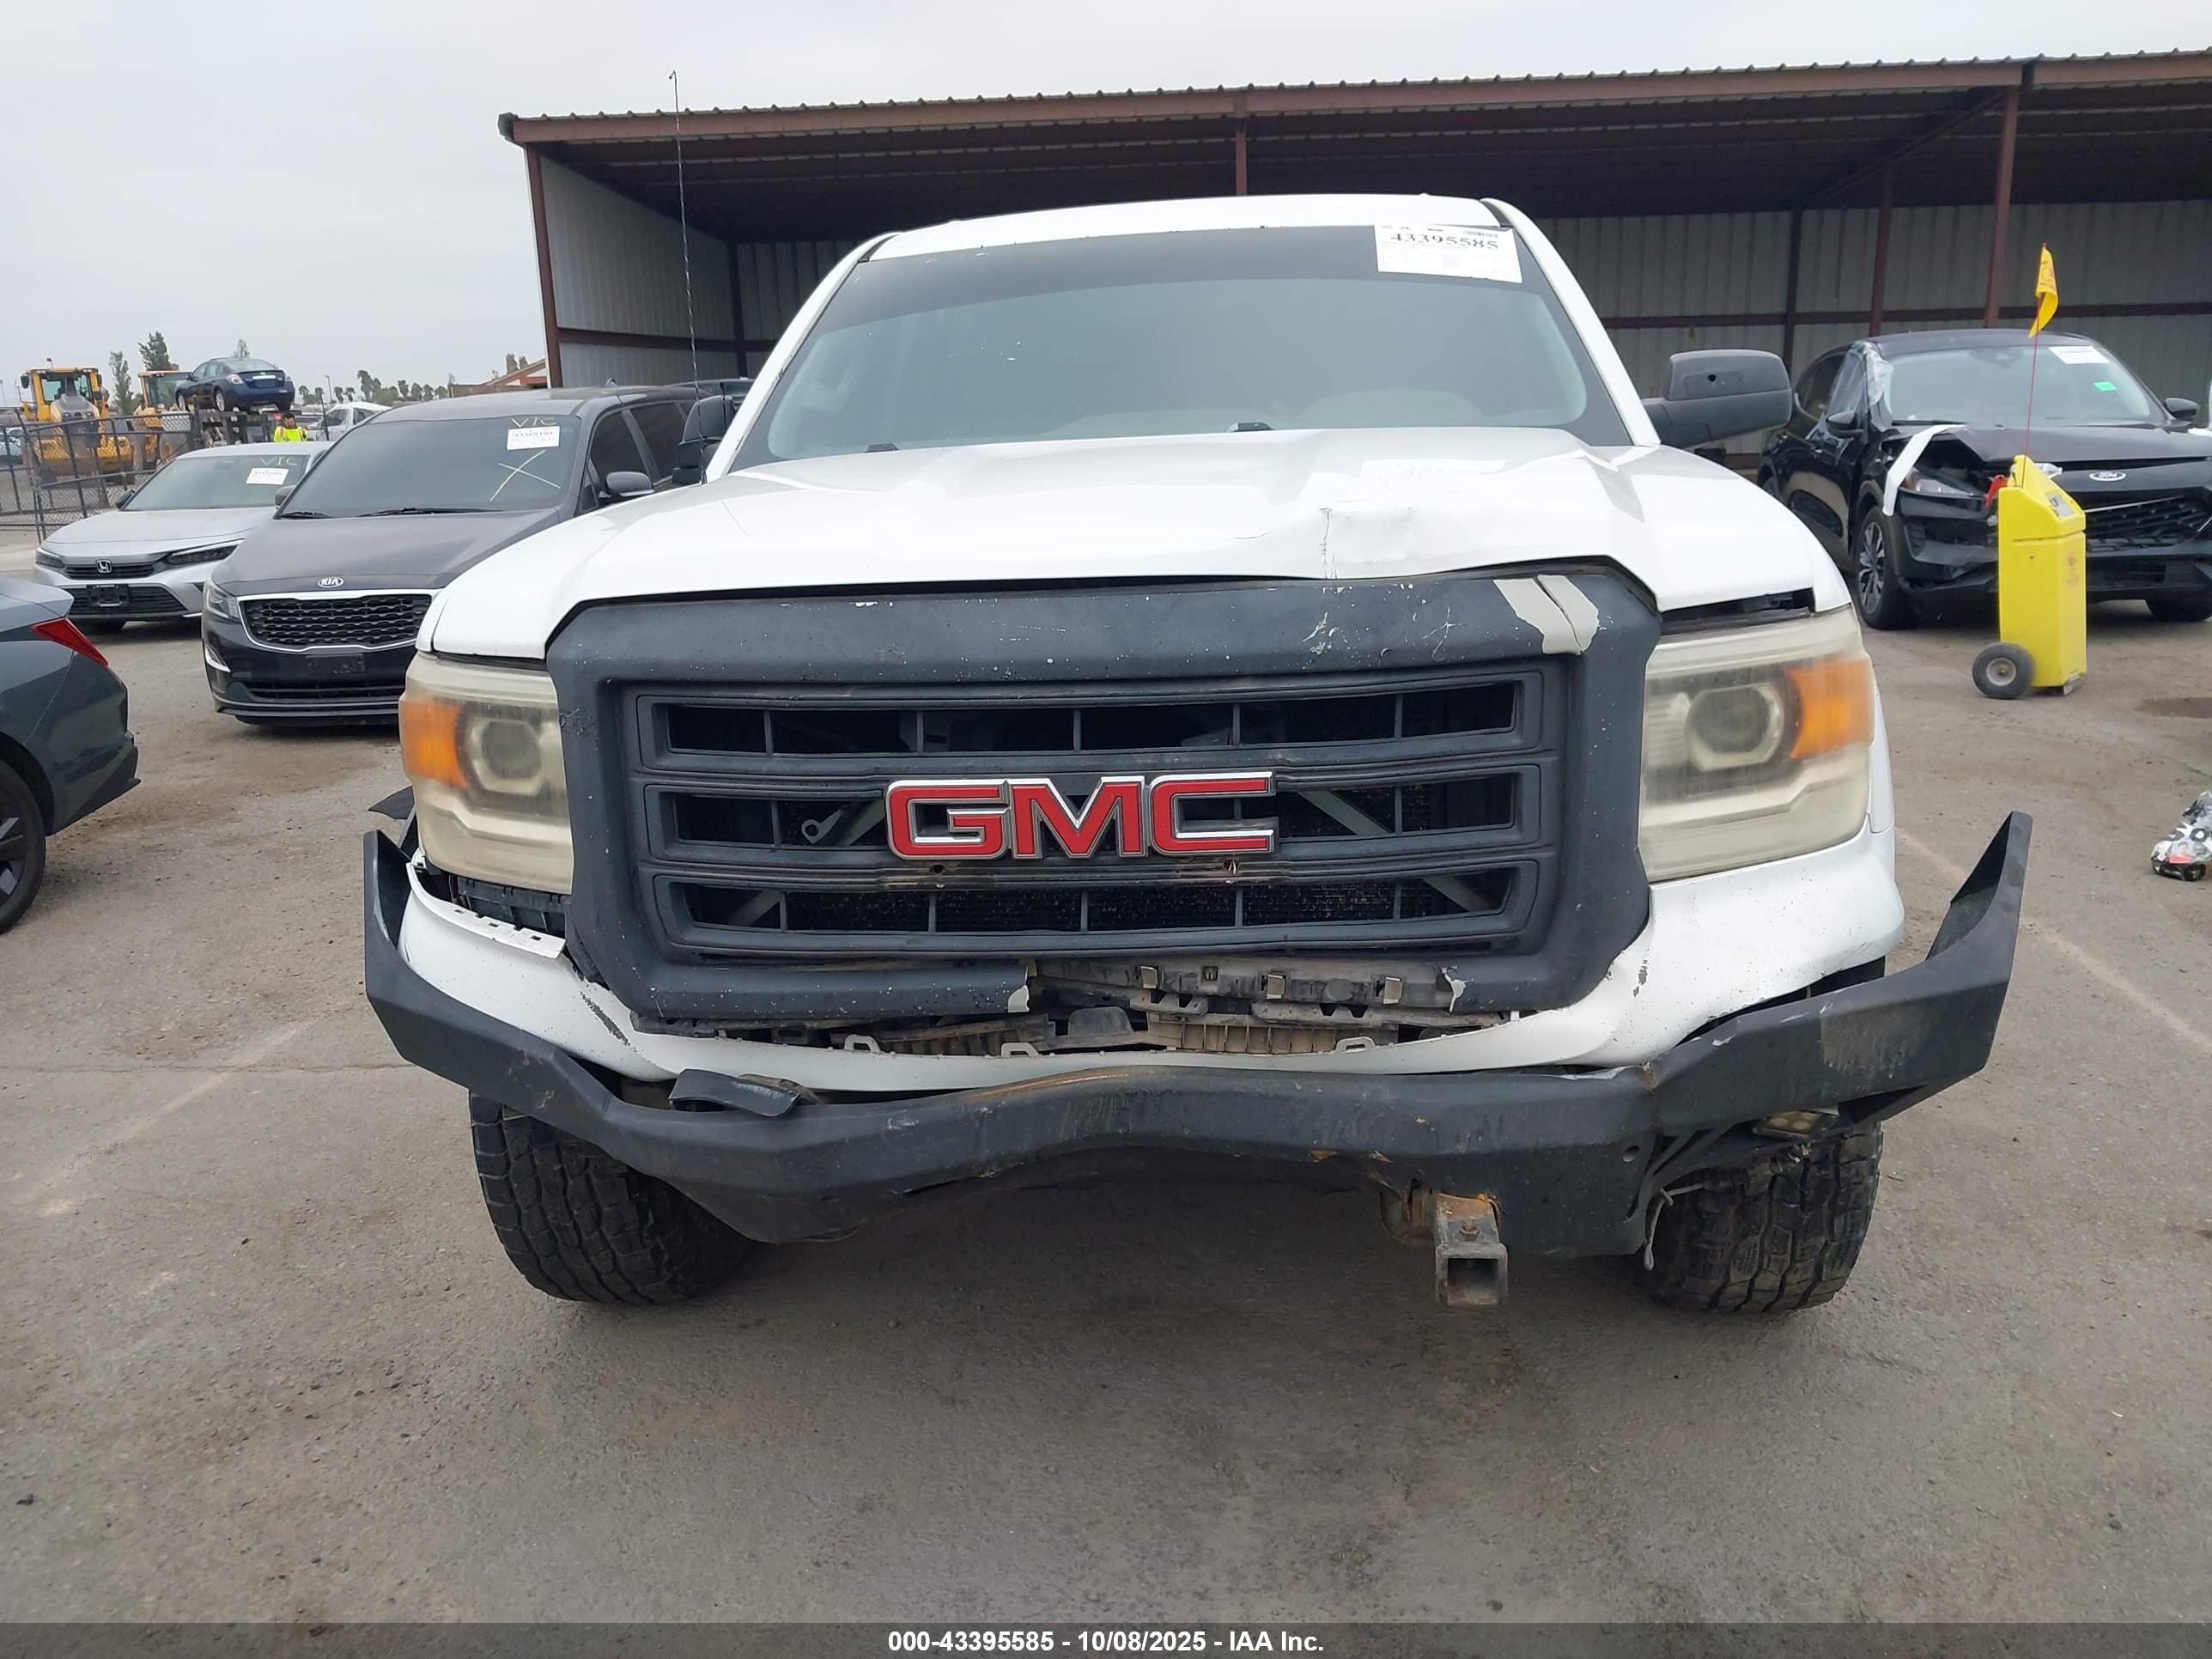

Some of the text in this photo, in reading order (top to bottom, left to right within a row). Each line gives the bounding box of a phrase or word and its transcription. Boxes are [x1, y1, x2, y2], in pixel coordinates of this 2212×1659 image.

[1390, 233, 1498, 249] 43395585
[510, 416, 557, 428] VIC
[886, 771, 1278, 860] GMC
